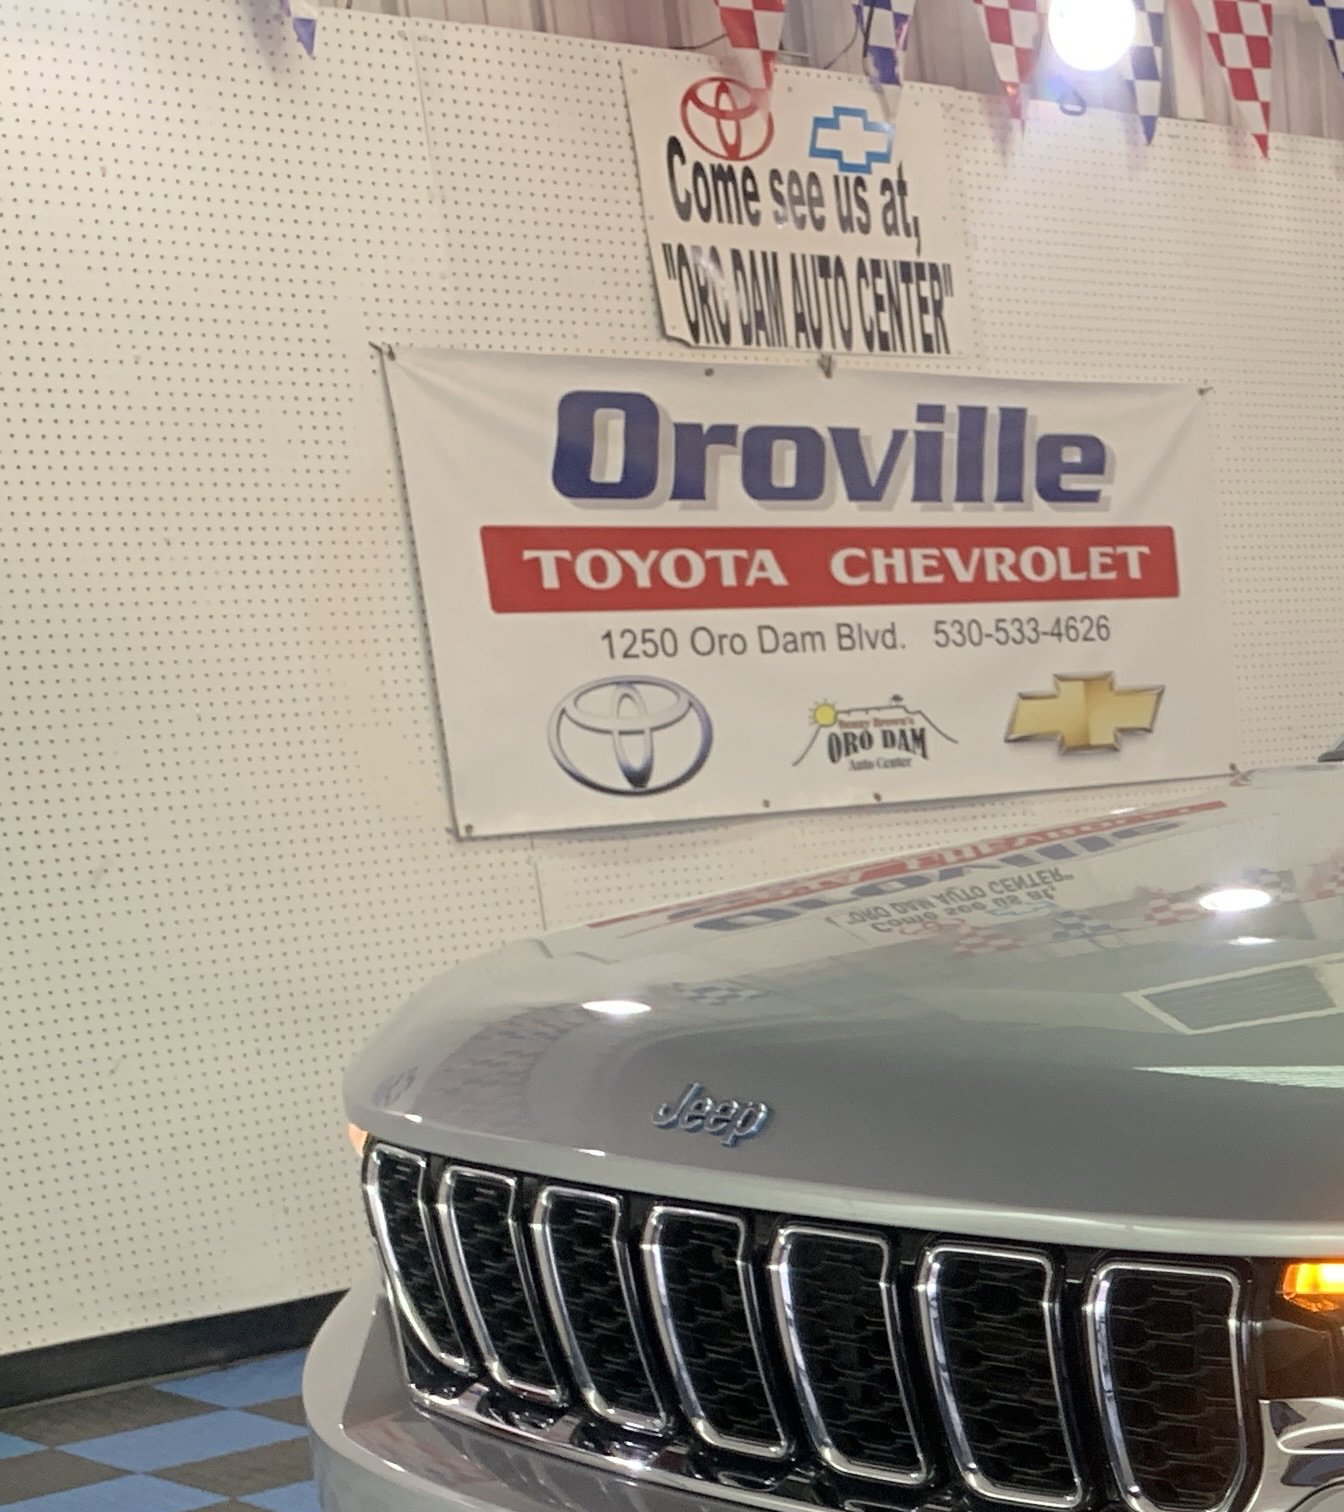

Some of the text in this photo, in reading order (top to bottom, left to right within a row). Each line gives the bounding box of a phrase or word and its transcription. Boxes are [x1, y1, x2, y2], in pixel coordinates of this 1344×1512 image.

[667, 135, 921, 257] Come see us at,
[730, 248, 788, 348] DAM
[791, 252, 853, 350] AUTO
[856, 256, 953, 355] CENTER"
[552, 389, 1108, 508] Oroville
[522, 545, 1152, 591] TOYOTA CHEVROLET
[600, 614, 1113, 661] 1250 Oro Dam Blvd. 530-533-4626
[827, 727, 930, 765] ORO DAM
[652, 1082, 769, 1148] Jeep
